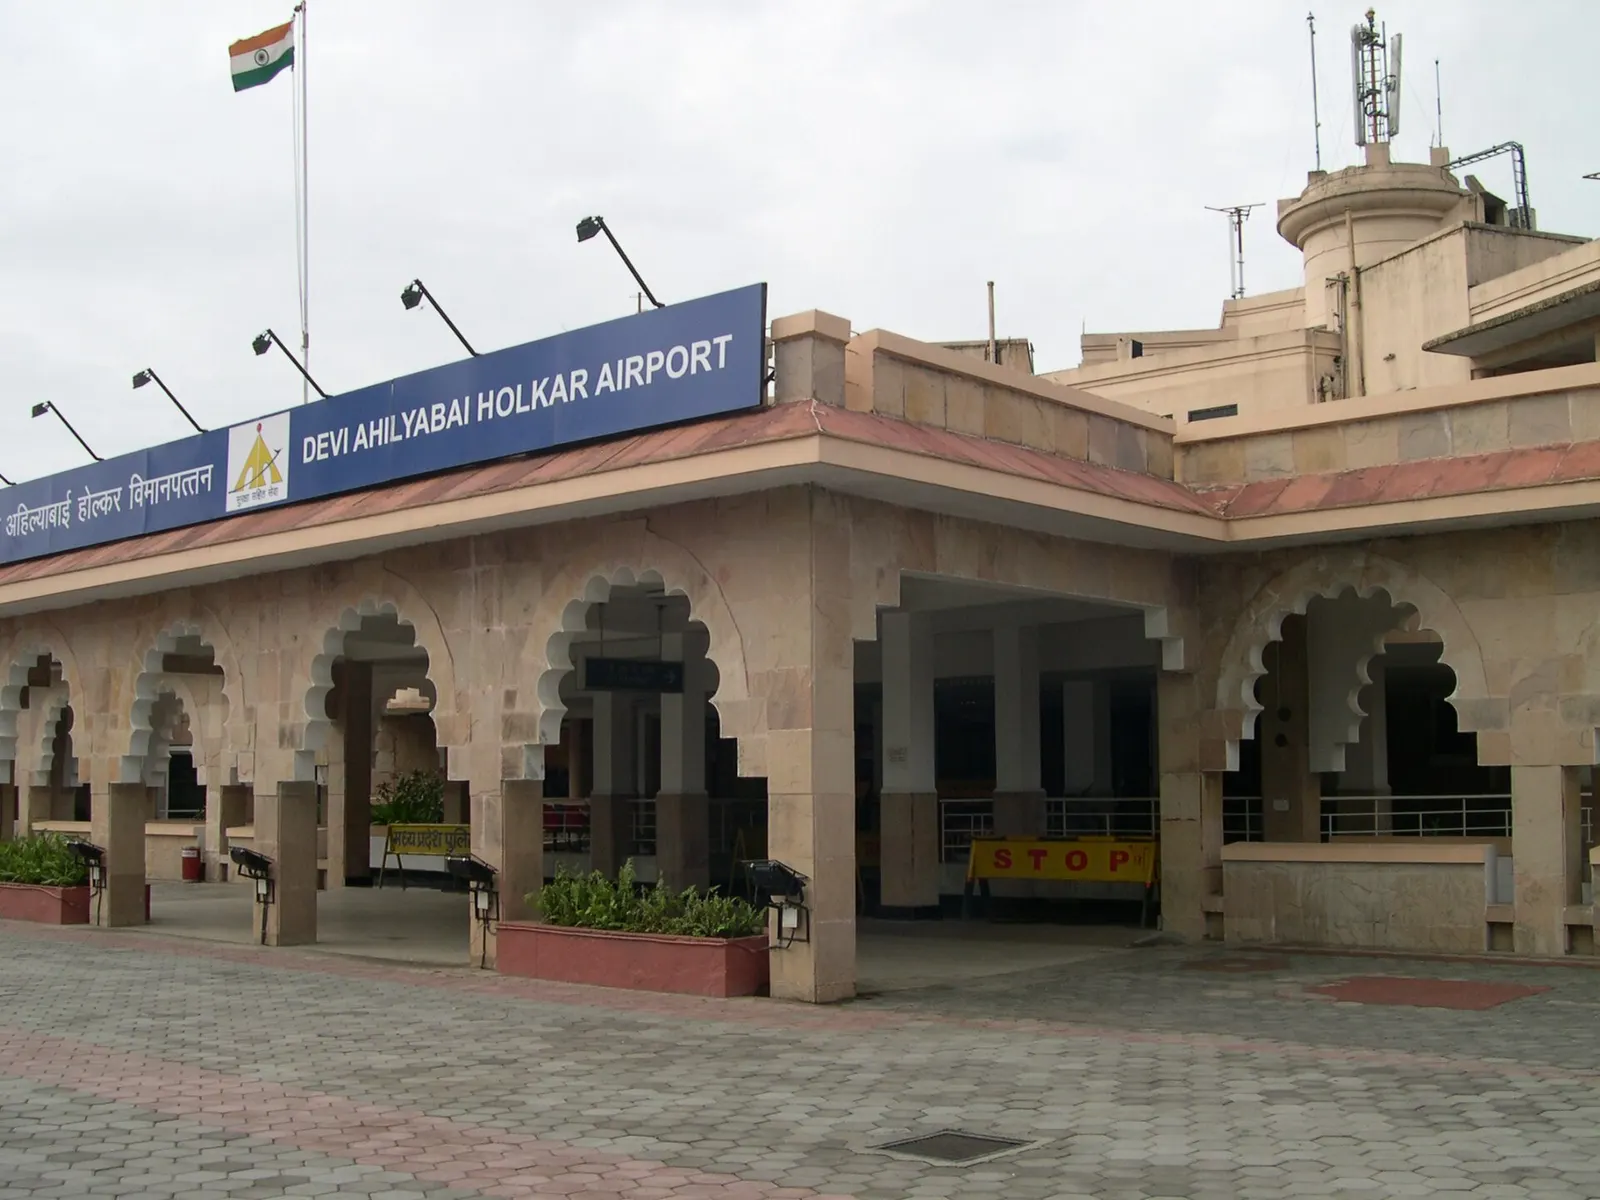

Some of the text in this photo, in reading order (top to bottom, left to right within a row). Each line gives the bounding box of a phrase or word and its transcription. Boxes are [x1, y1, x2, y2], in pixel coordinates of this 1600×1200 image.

[303, 334, 734, 464] DEVI AHILYABAI HOLKAR AIRPORT
[6, 464, 214, 536] अहिल्याबाई होल्कर विमानपत्तन
[445, 828, 470, 853] पुलि
[993, 848, 1129, 872] STOP
